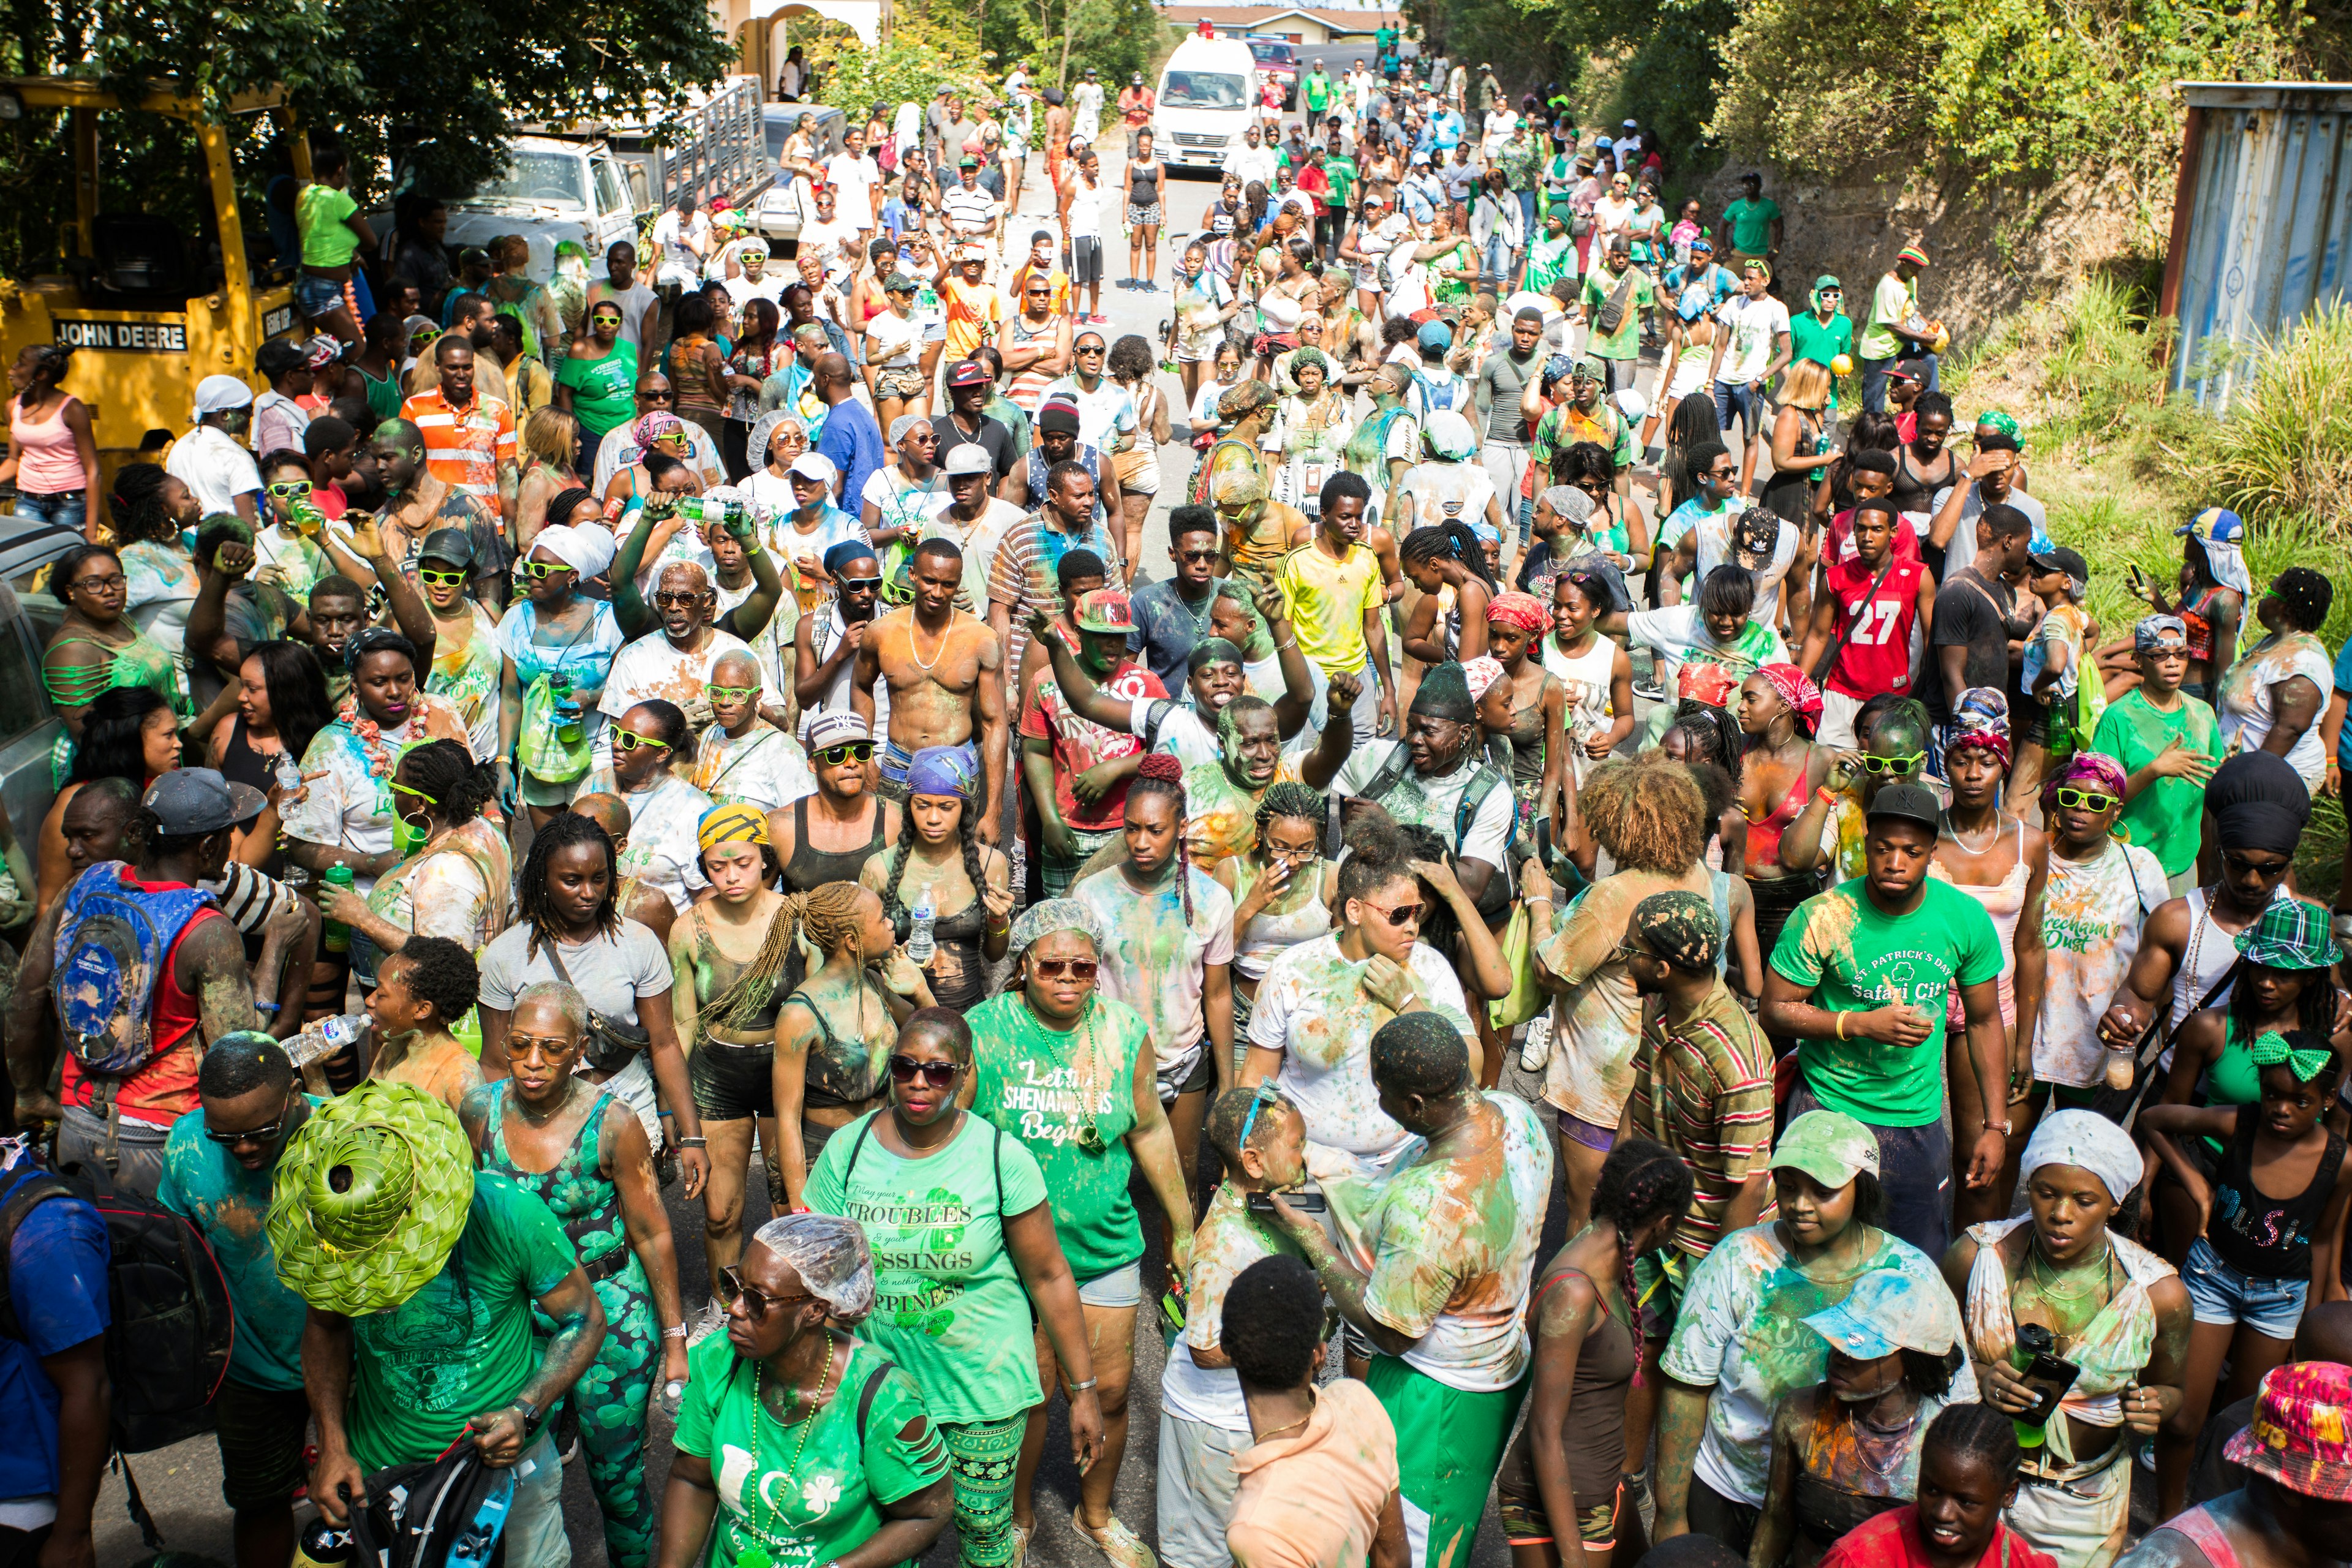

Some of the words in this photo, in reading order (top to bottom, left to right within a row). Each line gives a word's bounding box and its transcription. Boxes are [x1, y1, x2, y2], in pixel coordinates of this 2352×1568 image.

[56, 323, 113, 346] JOHN
[119, 325, 185, 349] DEERE
[1849, 600, 1901, 644] 27
[450, 677, 491, 701] Dust
[833, 715, 853, 730] NY
[1897, 790, 1917, 809] NY
[2046, 929, 2094, 954] Dust
[1854, 968, 1871, 982] ST.
[1871, 950, 1933, 968] PATRICK'S
[1934, 957, 1952, 976] DAY
[1852, 982, 1908, 1001] Safari
[1019, 1058, 1065, 1088] Let
[854, 1185, 877, 1200] May
[876, 1191, 897, 1201] your
[847, 1202, 972, 1224] TROUBLES
[884, 1236, 907, 1246] your
[873, 1251, 973, 1270] ESSINGS
[892, 1275, 925, 1287] nothing
[875, 1281, 966, 1313] PPINESS
[903, 1321, 926, 1332] your
[928, 1316, 948, 1326] door
[779, 1545, 816, 1557] DAY
